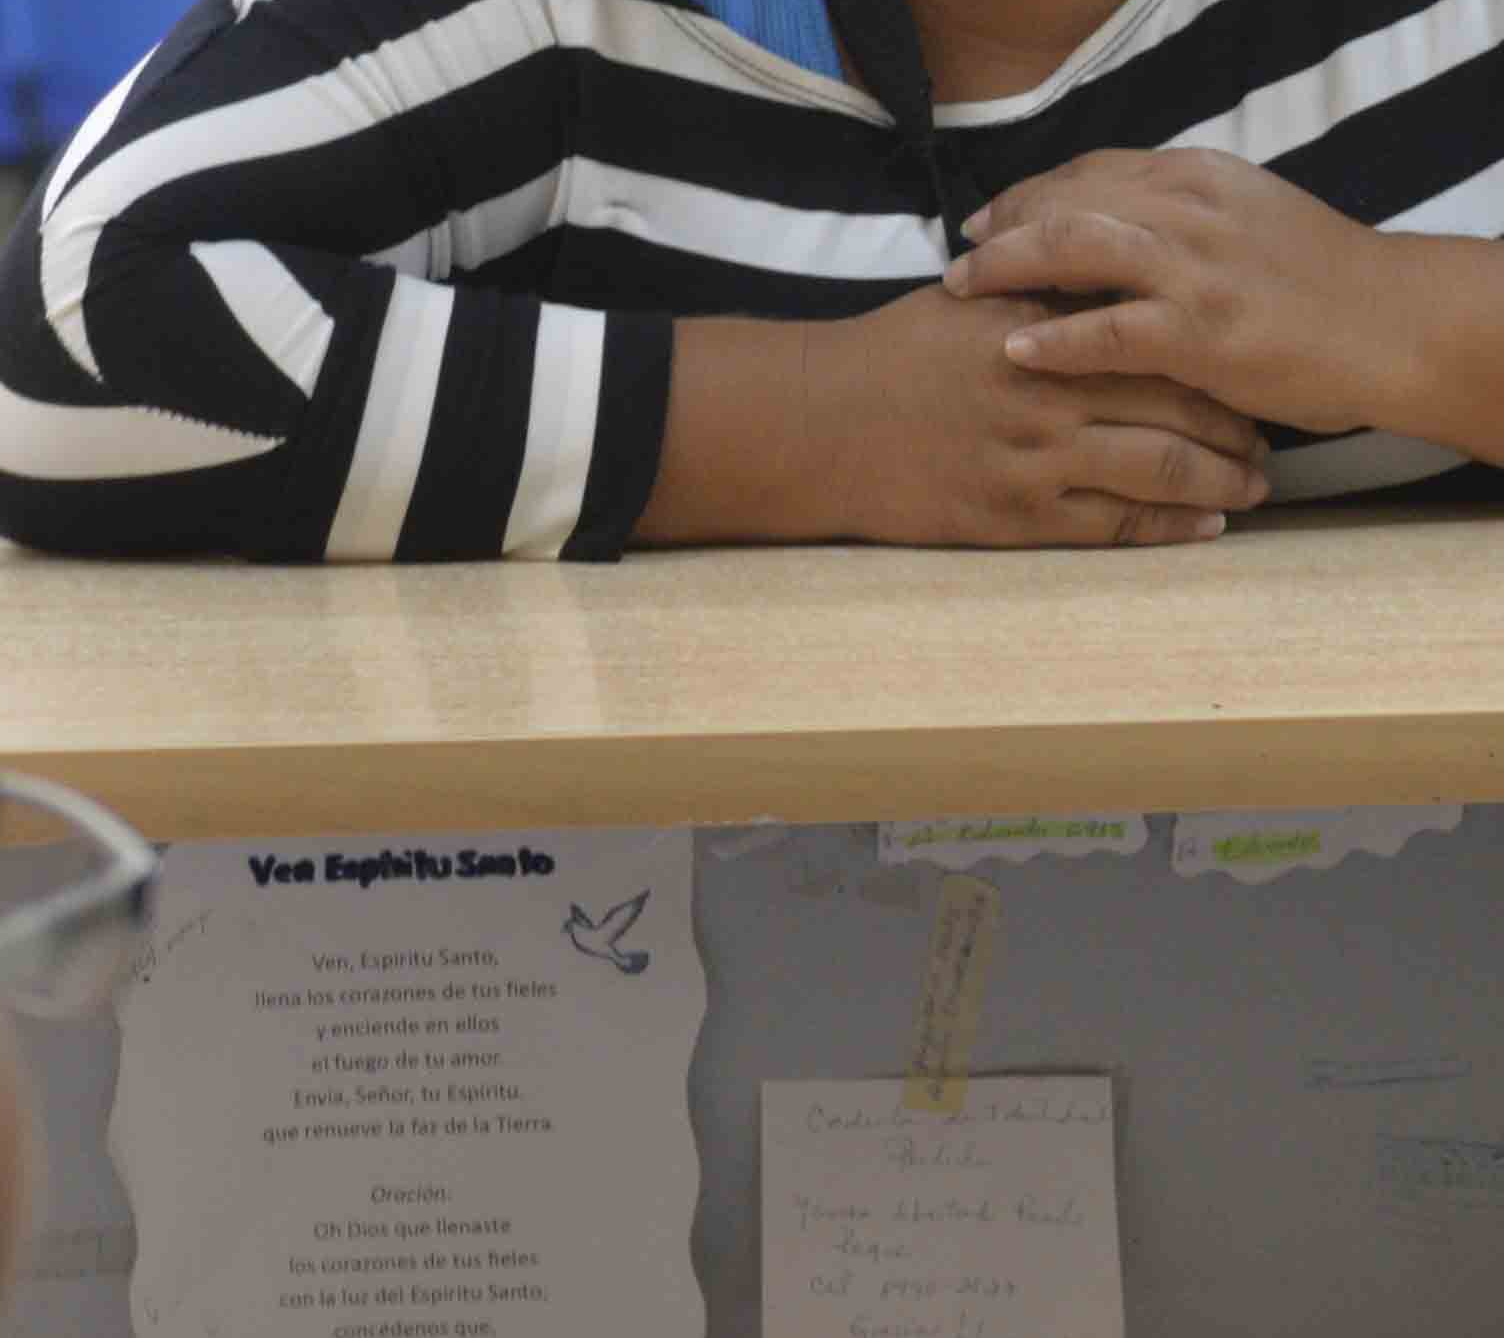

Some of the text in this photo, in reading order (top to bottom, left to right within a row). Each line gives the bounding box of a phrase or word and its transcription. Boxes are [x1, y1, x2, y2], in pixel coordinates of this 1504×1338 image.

[247, 856, 316, 887] Ven
[454, 848, 556, 878] Santo
[306, 988, 335, 1006] los
[441, 980, 466, 1001] de
[471, 982, 501, 1000] tus
[316, 1025, 329, 1043] y
[425, 1020, 449, 1034] en
[311, 1055, 330, 1074] el
[394, 1049, 420, 1070] de
[424, 1052, 445, 1075] tu
[420, 1084, 441, 1102] tu
[263, 1125, 300, 1147] que
[388, 1119, 405, 1137] la
[443, 1116, 468, 1135] de
[472, 1116, 491, 1134] la
[393, 1220, 431, 1242] que
[288, 1256, 317, 1278] los
[423, 1252, 447, 1270] de
[452, 1252, 482, 1270] tus
[279, 1293, 315, 1310] con
[318, 1288, 337, 1310] la
[374, 1284, 404, 1306] del
